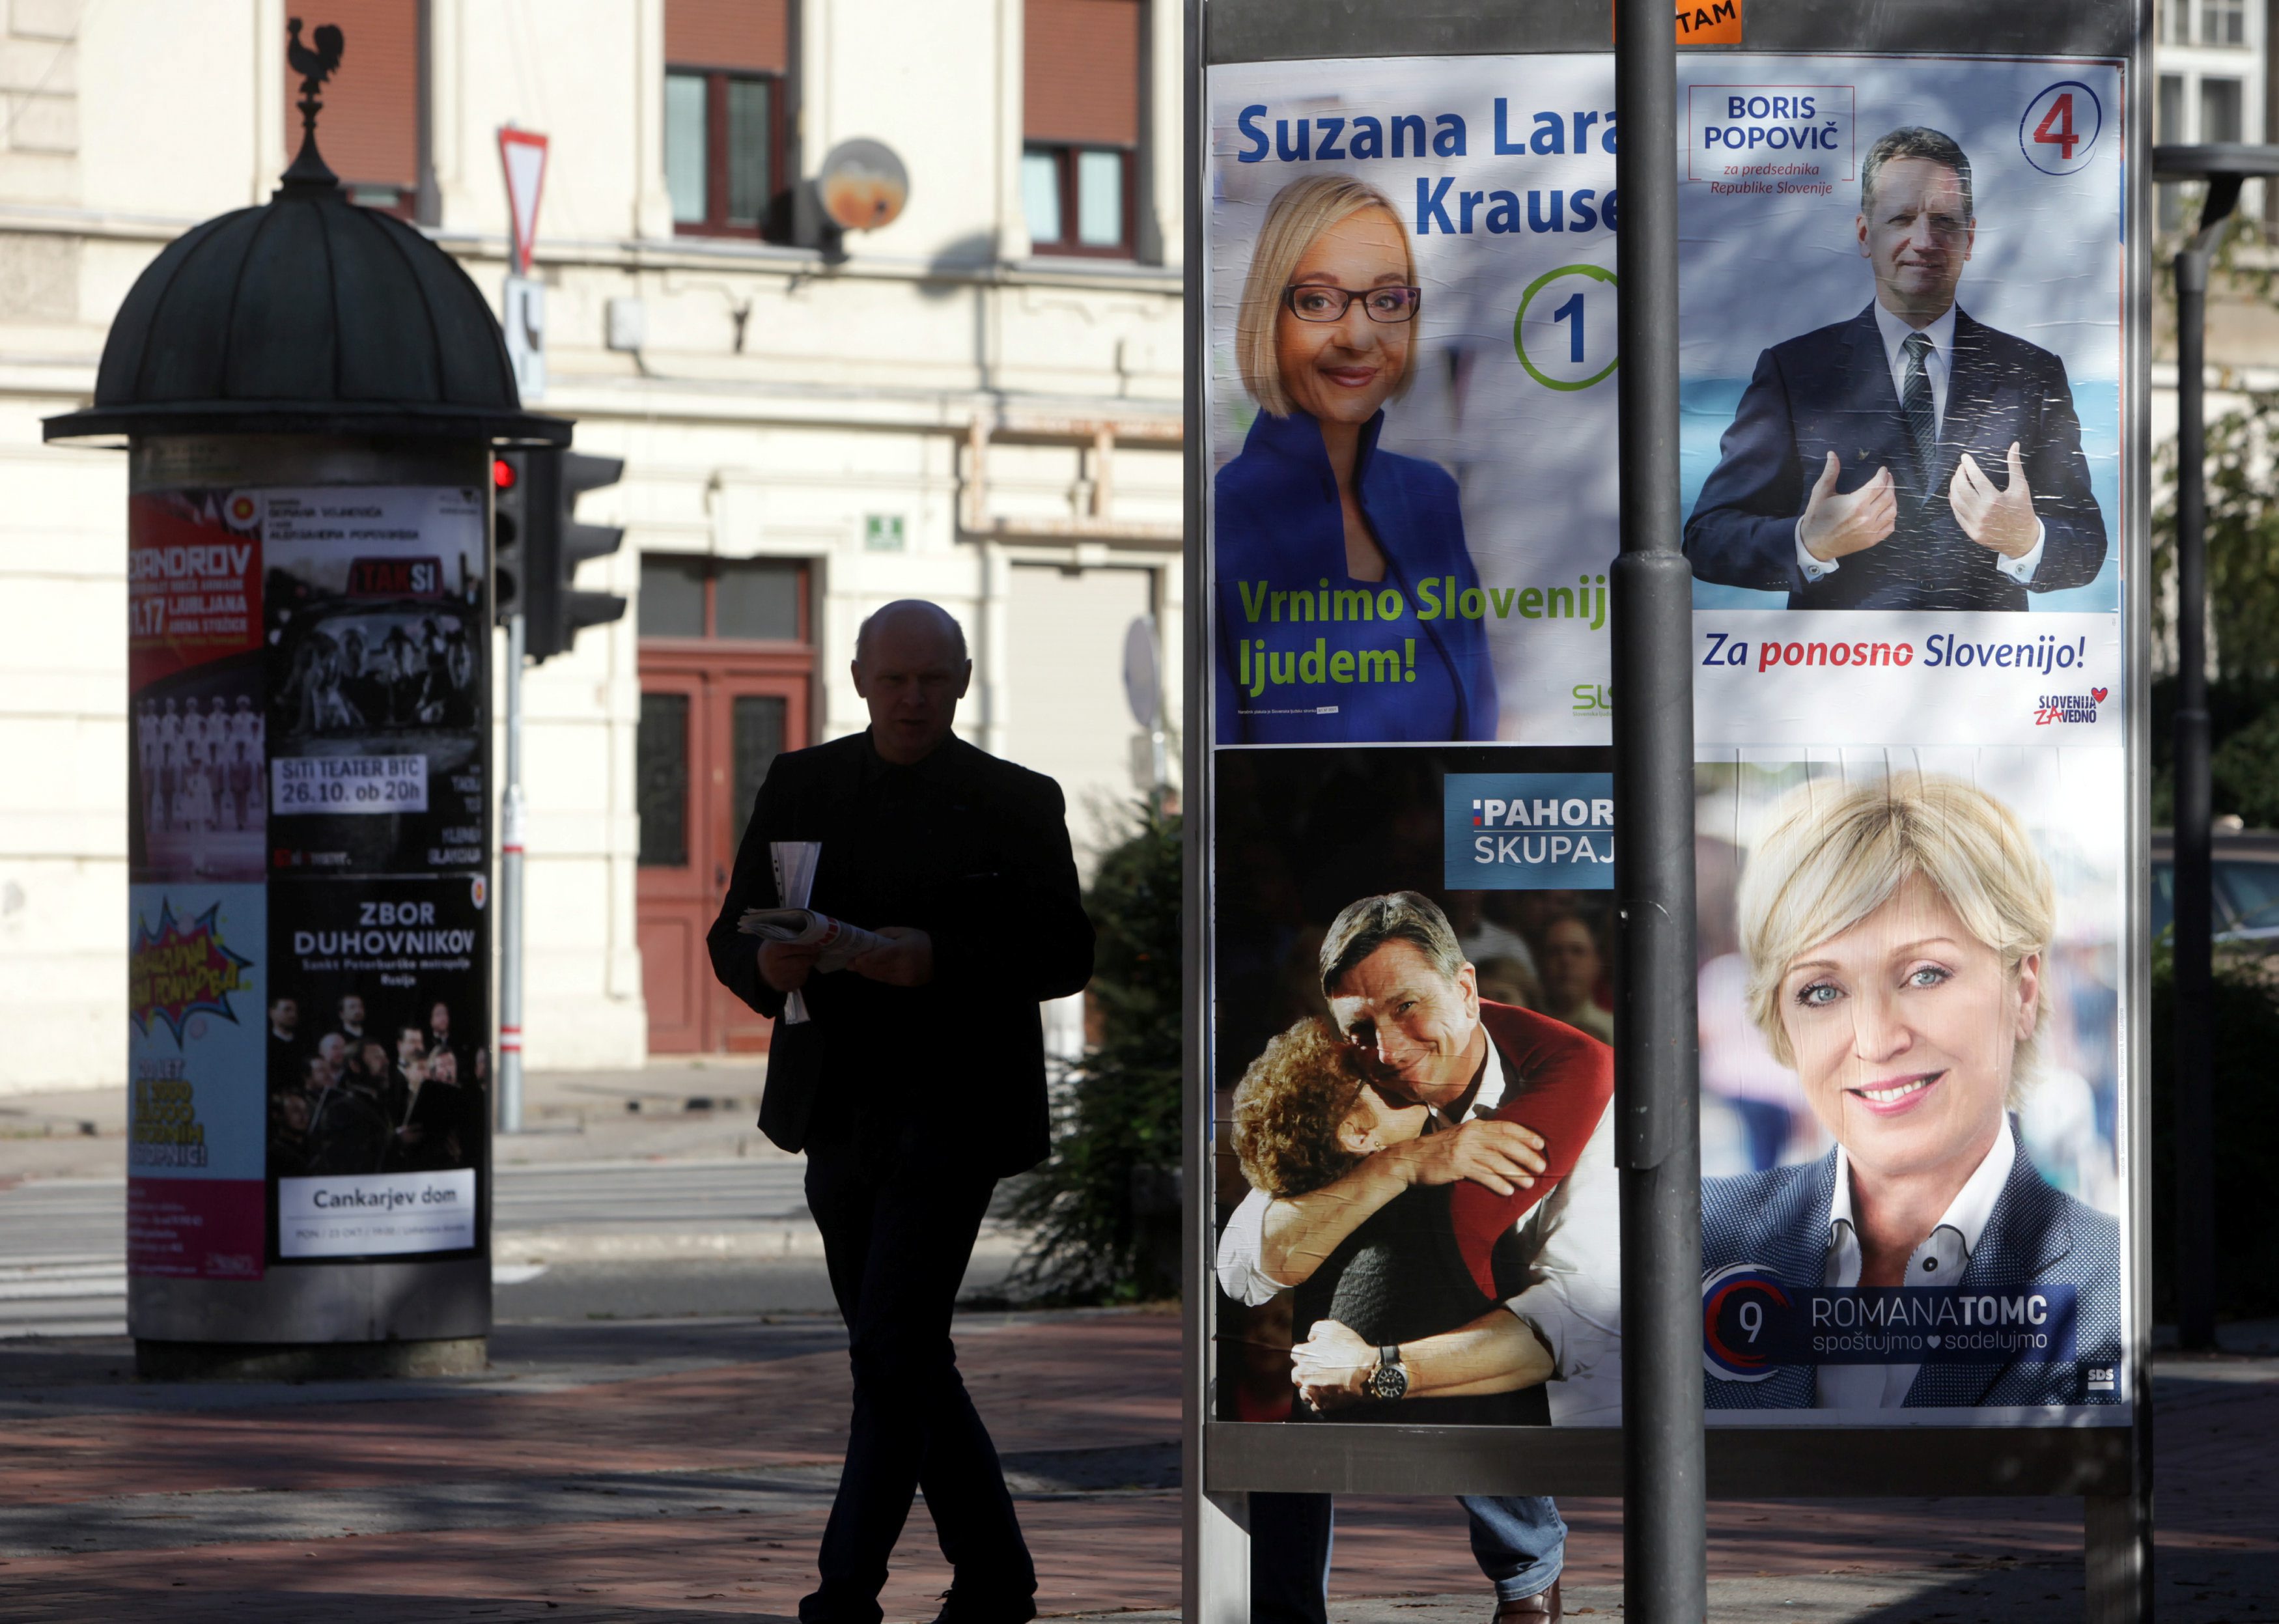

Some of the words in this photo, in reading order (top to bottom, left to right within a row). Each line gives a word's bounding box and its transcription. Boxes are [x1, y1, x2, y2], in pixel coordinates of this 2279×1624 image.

[1676, 0, 1736, 33] TAM
[1727, 96, 1815, 119] BORIS
[1237, 104, 1467, 163] Suzana
[1704, 121, 1838, 150] POPOVIČ
[2033, 93, 2079, 160] 4
[1724, 165, 1739, 176] za
[1741, 161, 1820, 178] predsednika
[1711, 181, 1773, 195] Republike
[1776, 181, 1833, 196] Slovenije
[1554, 293, 1584, 363] 1
[1238, 578, 1403, 623] Vrnimo
[1416, 574, 1606, 630] Slovenij
[1239, 637, 1416, 698] ljudem!
[1701, 633, 1748, 665] Za
[1759, 641, 1913, 672] ponosno
[1924, 634, 2086, 675] Slovenijo!
[1573, 684, 1614, 710] SL
[2038, 695, 2097, 709] SLOVENIJA
[320, 759, 384, 778] TEATER
[387, 758, 419, 777] BTC
[356, 781, 380, 802] ob
[385, 780, 419, 801] 20h
[1473, 836, 1614, 864] SKUPAJ
[359, 901, 436, 926] ZBOR
[294, 929, 475, 956] DUHOVNIKOV
[380, 973, 417, 988] Rusija
[314, 1187, 416, 1211] Cankarjev
[421, 1184, 456, 1204] dom
[1739, 1301, 1763, 1343] 9
[1813, 1330, 1923, 1354] spoštujmo
[1944, 1330, 2047, 1352] sodelujmo
[2088, 1369, 2114, 1380] SDS
